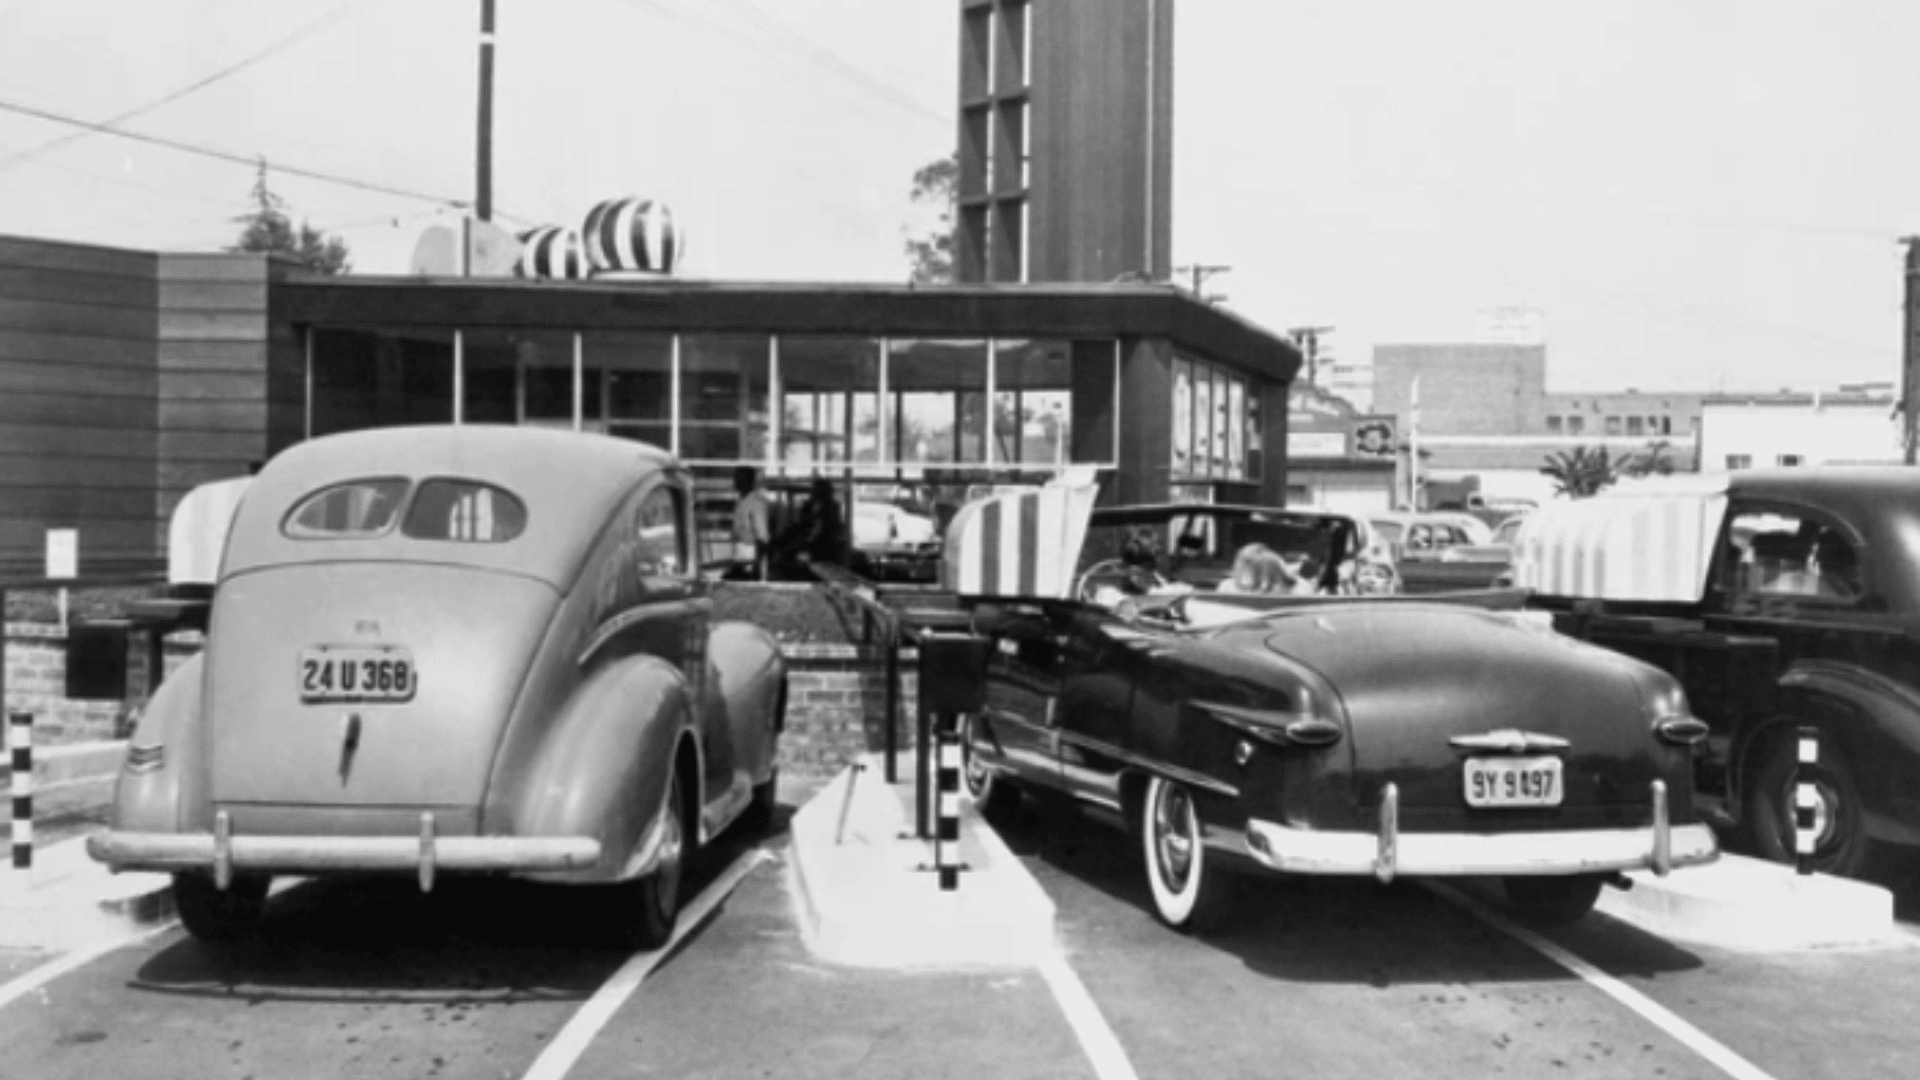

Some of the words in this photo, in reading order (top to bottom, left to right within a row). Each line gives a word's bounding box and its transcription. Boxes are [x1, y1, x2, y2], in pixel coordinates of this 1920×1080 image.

[303, 659, 334, 691] 24
[341, 660, 357, 691] U
[362, 659, 408, 691] 368
[1473, 770, 1498, 798] 9Y
